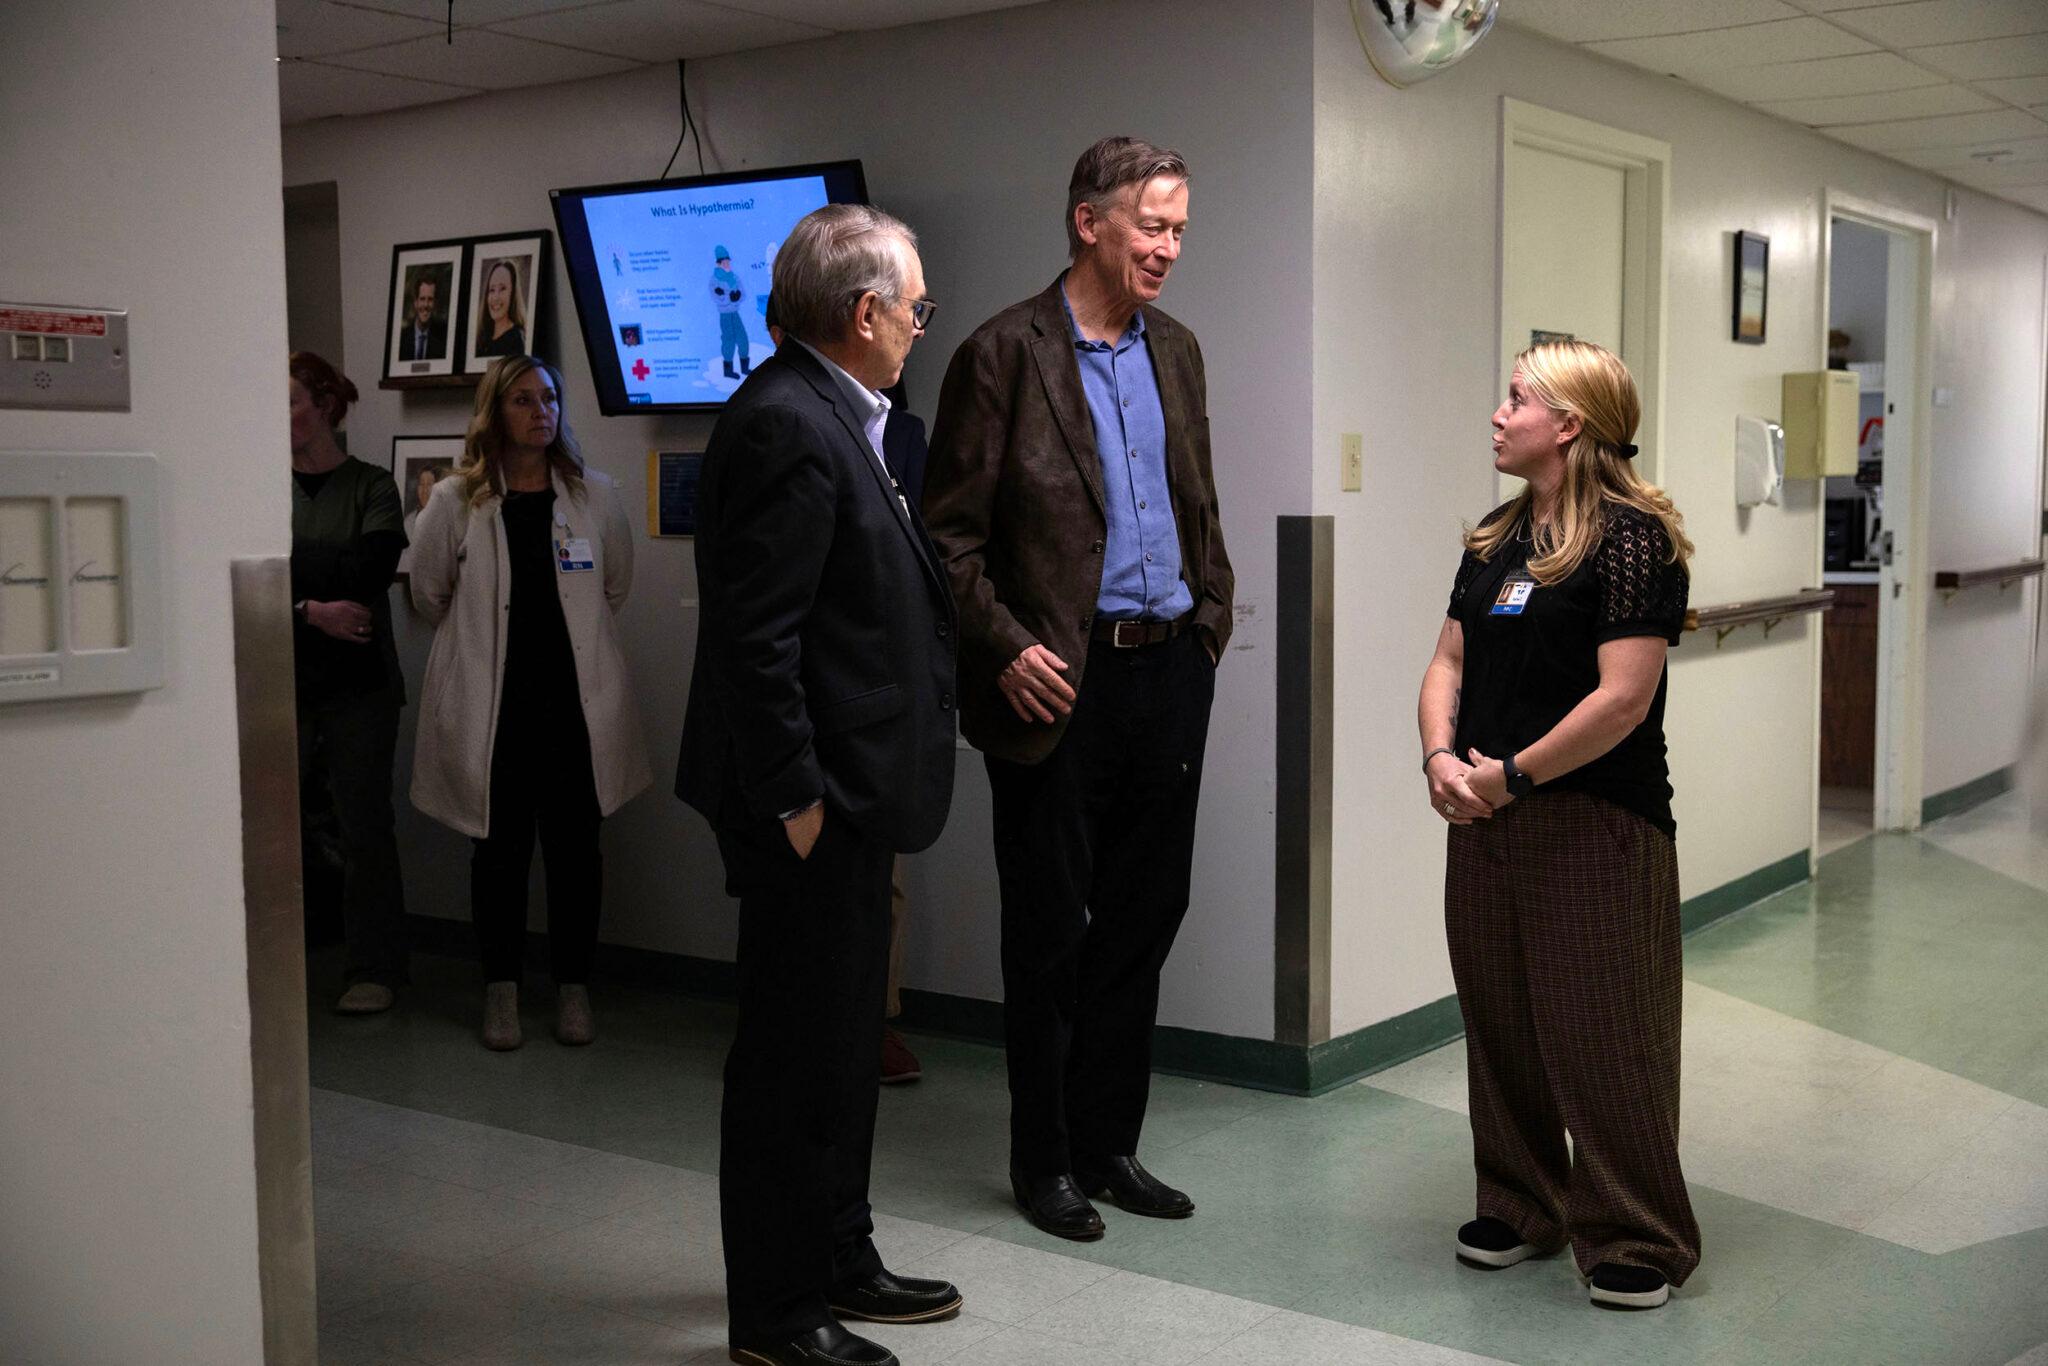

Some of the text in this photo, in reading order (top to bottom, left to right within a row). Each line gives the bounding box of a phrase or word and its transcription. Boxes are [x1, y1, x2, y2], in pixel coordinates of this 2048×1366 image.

[651, 198, 754, 217] What Is Hypothermia?
